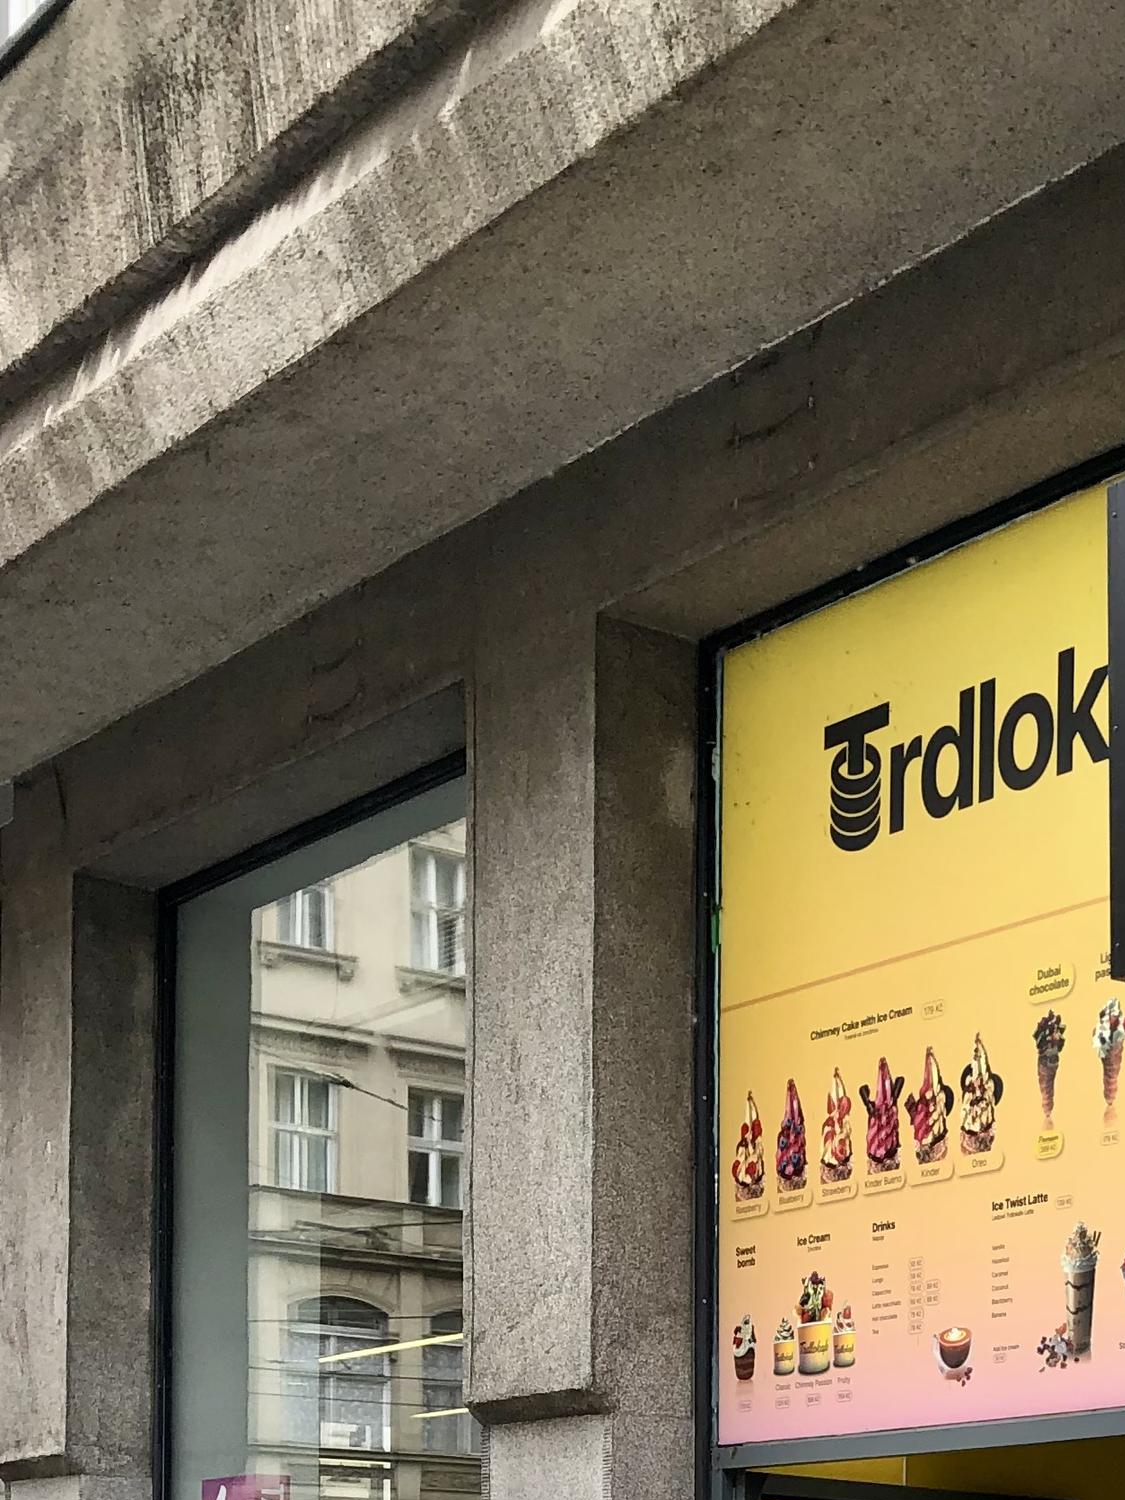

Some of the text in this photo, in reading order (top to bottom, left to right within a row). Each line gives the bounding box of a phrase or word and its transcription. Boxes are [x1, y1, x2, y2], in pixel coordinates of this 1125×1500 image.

[825, 646, 1110, 852] Trdlok
[1037, 963, 1061, 981] Dubai
[1029, 978, 1070, 996] chocolate
[810, 1026, 840, 1041] Chimney
[841, 1021, 860, 1033] Cake
[860, 1015, 876, 1028] with
[877, 1013, 888, 1023] Ice
[888, 1006, 913, 1020] Cream
[921, 1167, 940, 1177] Kinder
[992, 1201, 1004, 1211] Ice
[1005, 1196, 1027, 1209] Twist
[1028, 1193, 1048, 1205] Latte
[872, 1220, 895, 1233] Drinks
[797, 1233, 831, 1247] Ice Cream
[736, 1245, 756, 1257] Sweet
[737, 1257, 755, 1268] bomb
